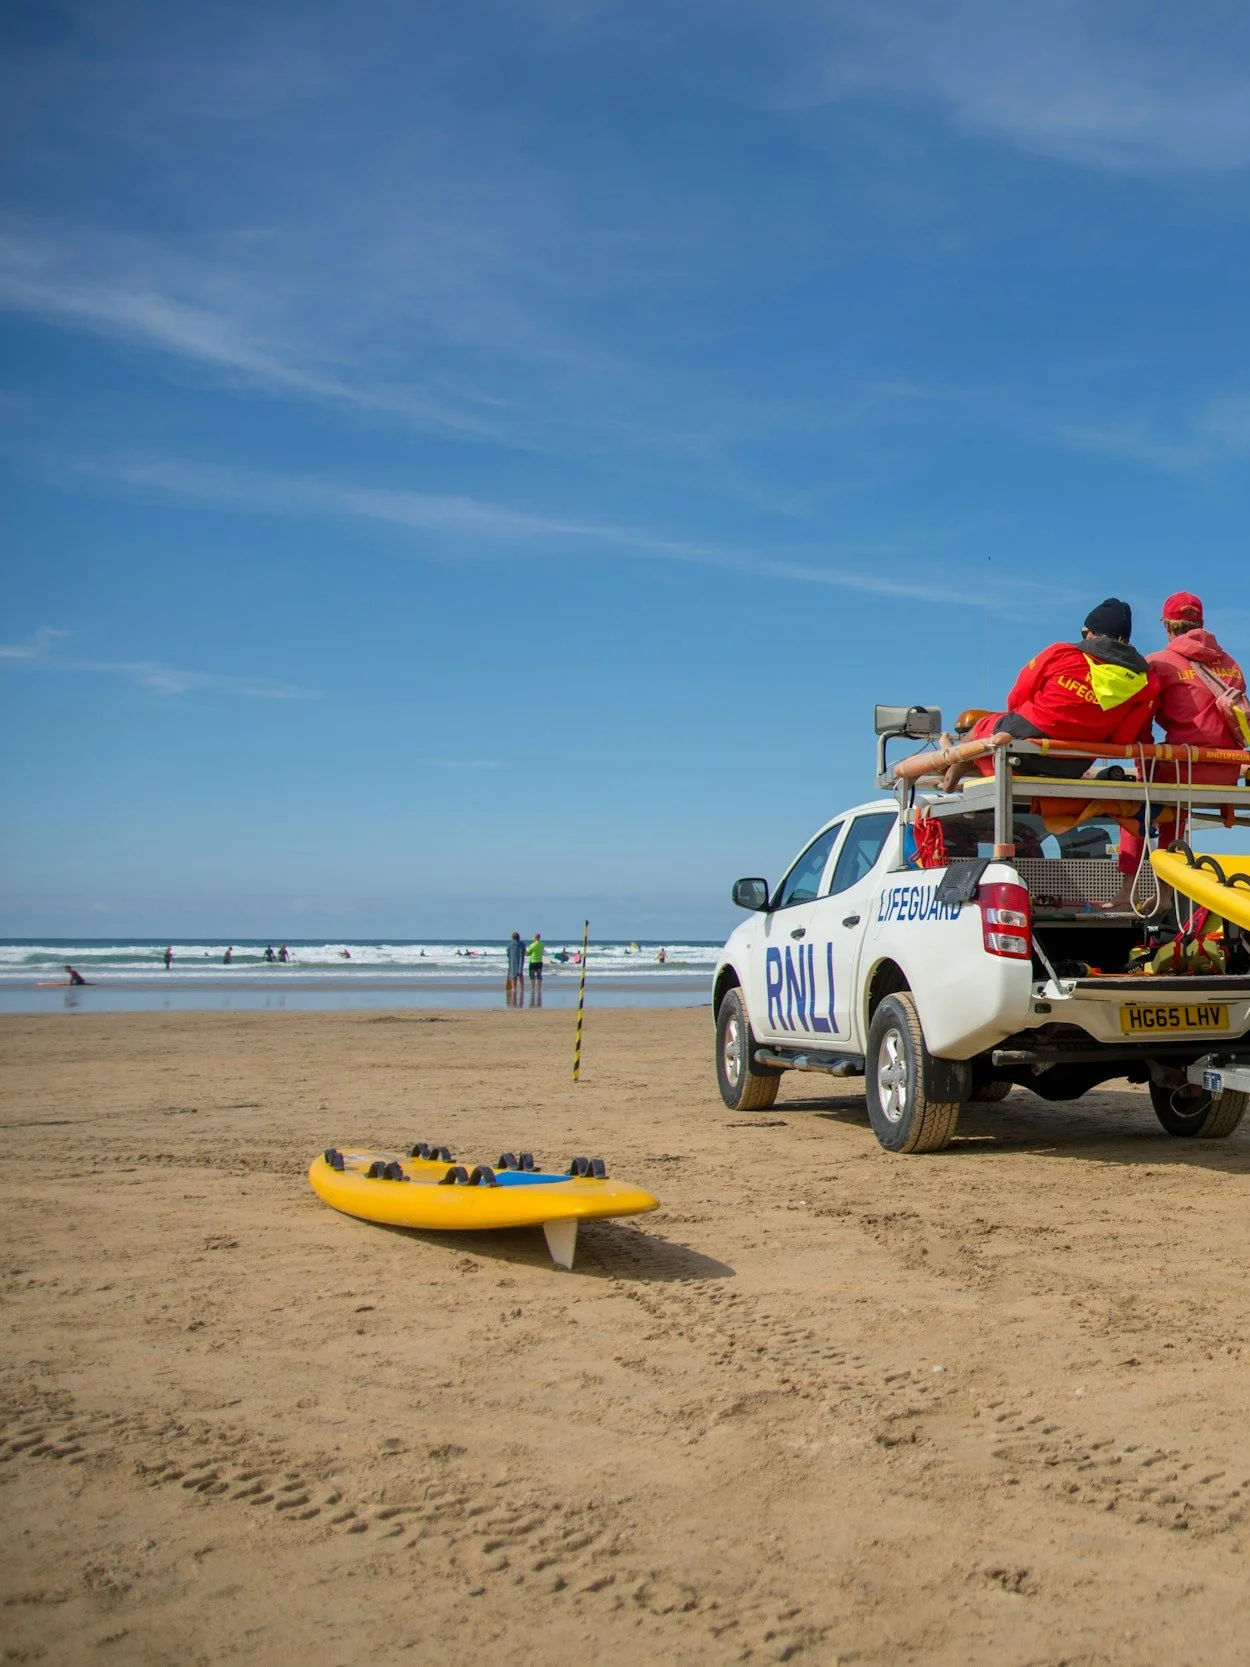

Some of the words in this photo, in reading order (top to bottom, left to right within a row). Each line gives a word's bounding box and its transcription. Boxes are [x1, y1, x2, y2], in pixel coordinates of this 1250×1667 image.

[1177, 666, 1242, 680] LIFUARD
[766, 942, 840, 1033] RNLI
[1129, 1008, 1180, 1028] HG65
[1185, 1007, 1220, 1026] LHV
